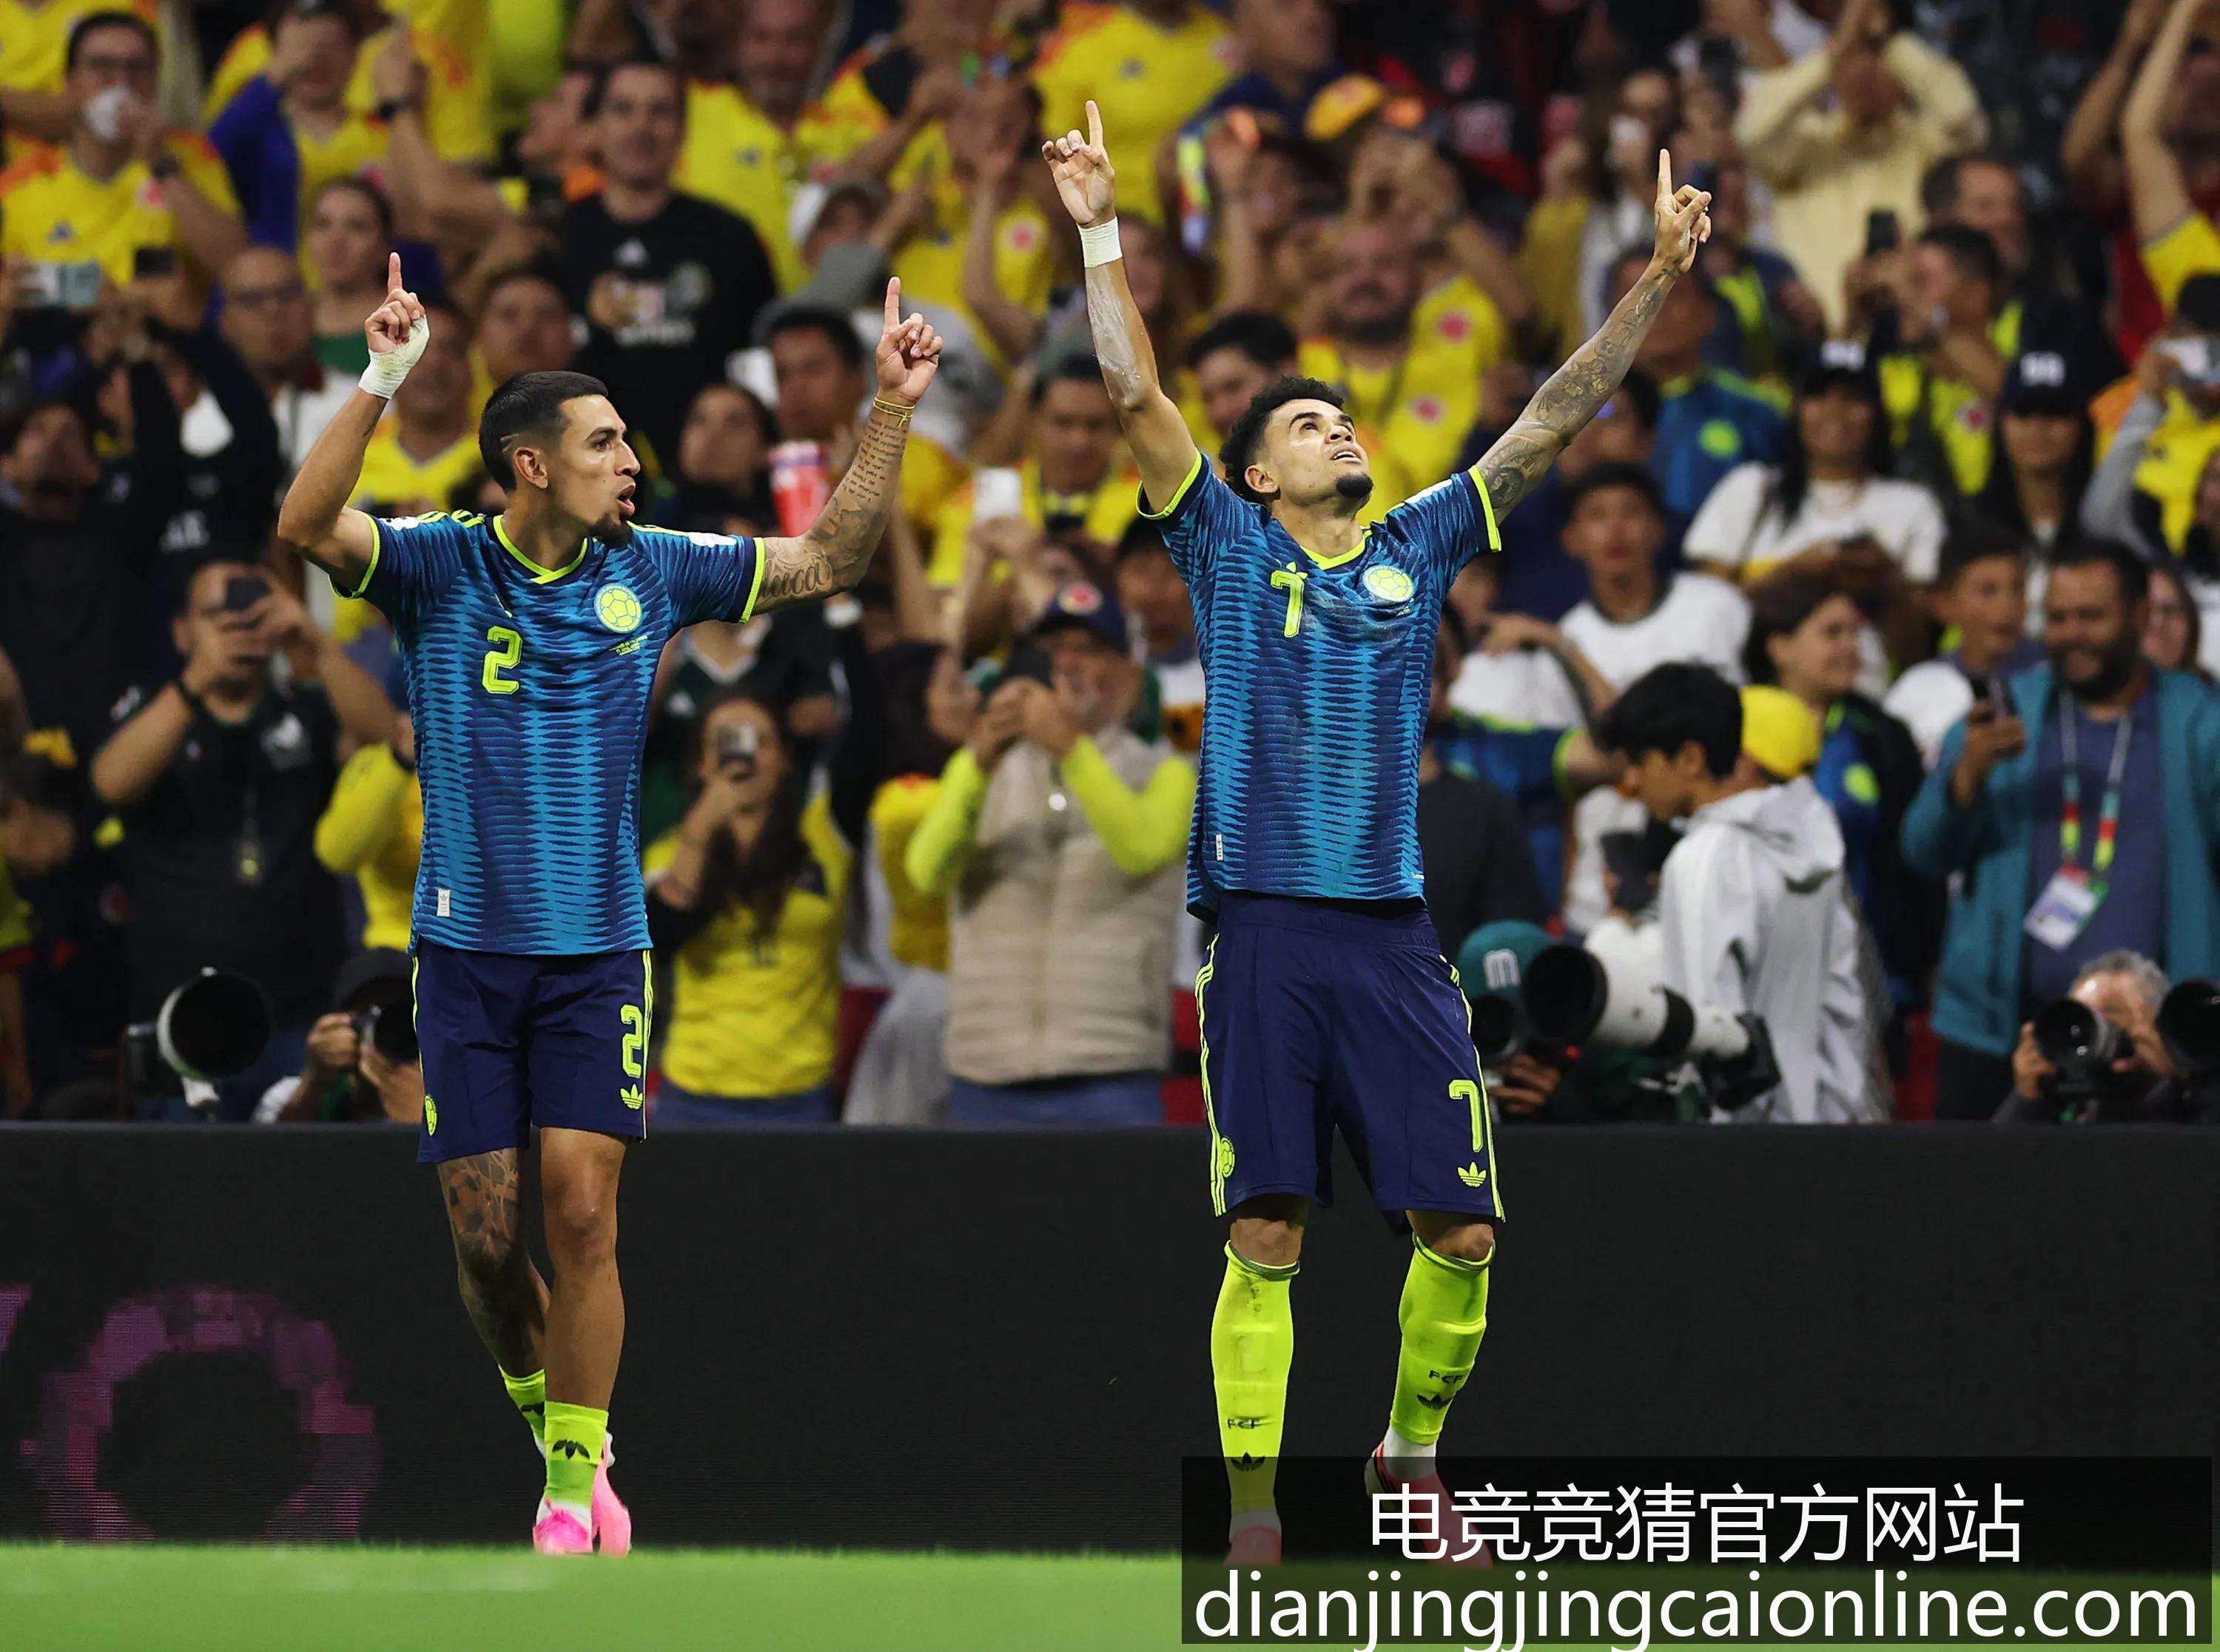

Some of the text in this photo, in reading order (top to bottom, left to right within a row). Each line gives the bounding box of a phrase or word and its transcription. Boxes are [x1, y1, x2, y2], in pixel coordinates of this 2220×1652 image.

[1270, 569, 1305, 638] 7
[482, 625, 523, 695] 2
[620, 1004, 643, 1079] 2
[1448, 1079, 1484, 1153] 7
[1428, 1369, 1464, 1384] FCF
